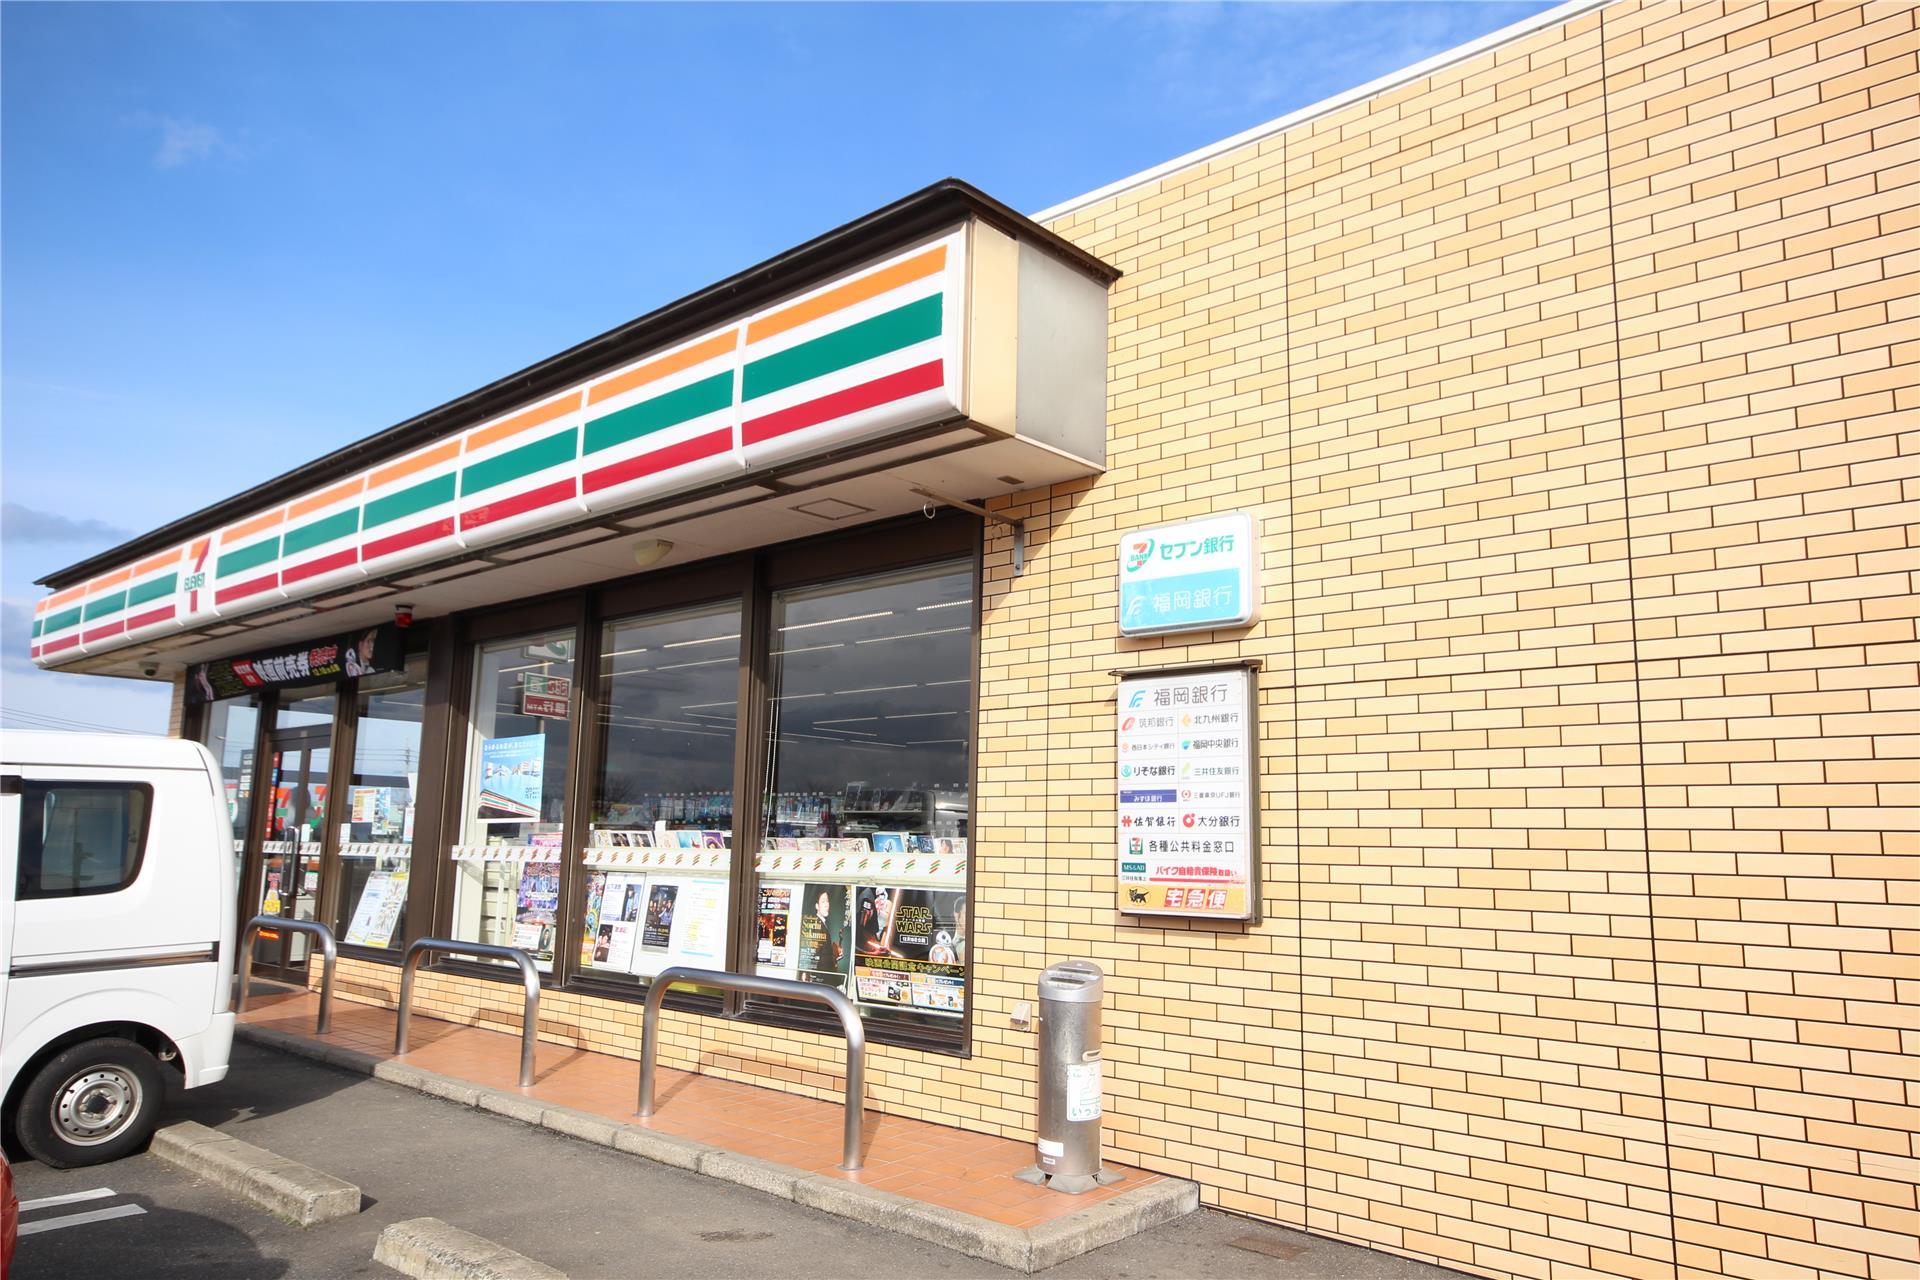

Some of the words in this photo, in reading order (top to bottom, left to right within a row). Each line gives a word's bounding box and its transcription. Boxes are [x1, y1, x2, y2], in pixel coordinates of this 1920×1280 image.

[1160, 534, 1234, 560] セブン銀行
[1153, 585, 1232, 613] 福岡銀行
[252, 651, 310, 683] 映画前売券
[1153, 684, 1228, 706] 福岡銀行
[1194, 712, 1239, 725] 北九州銀行
[1131, 743, 1175, 751] 西日本シティ銀行
[1193, 738, 1239, 750] 福岡中央銀行
[1133, 765, 1176, 776] りそな銀行
[1194, 766, 1239, 776] 三井住友銀行
[1133, 816, 1176, 827] 佐賀銀行
[1198, 815, 1240, 827] 大分銀行
[1149, 840, 1234, 853] 各種公共料金窓口
[1164, 888, 1227, 909] 宅急便
[896, 905, 932, 919] STAR
[896, 921, 932, 935] WARS
